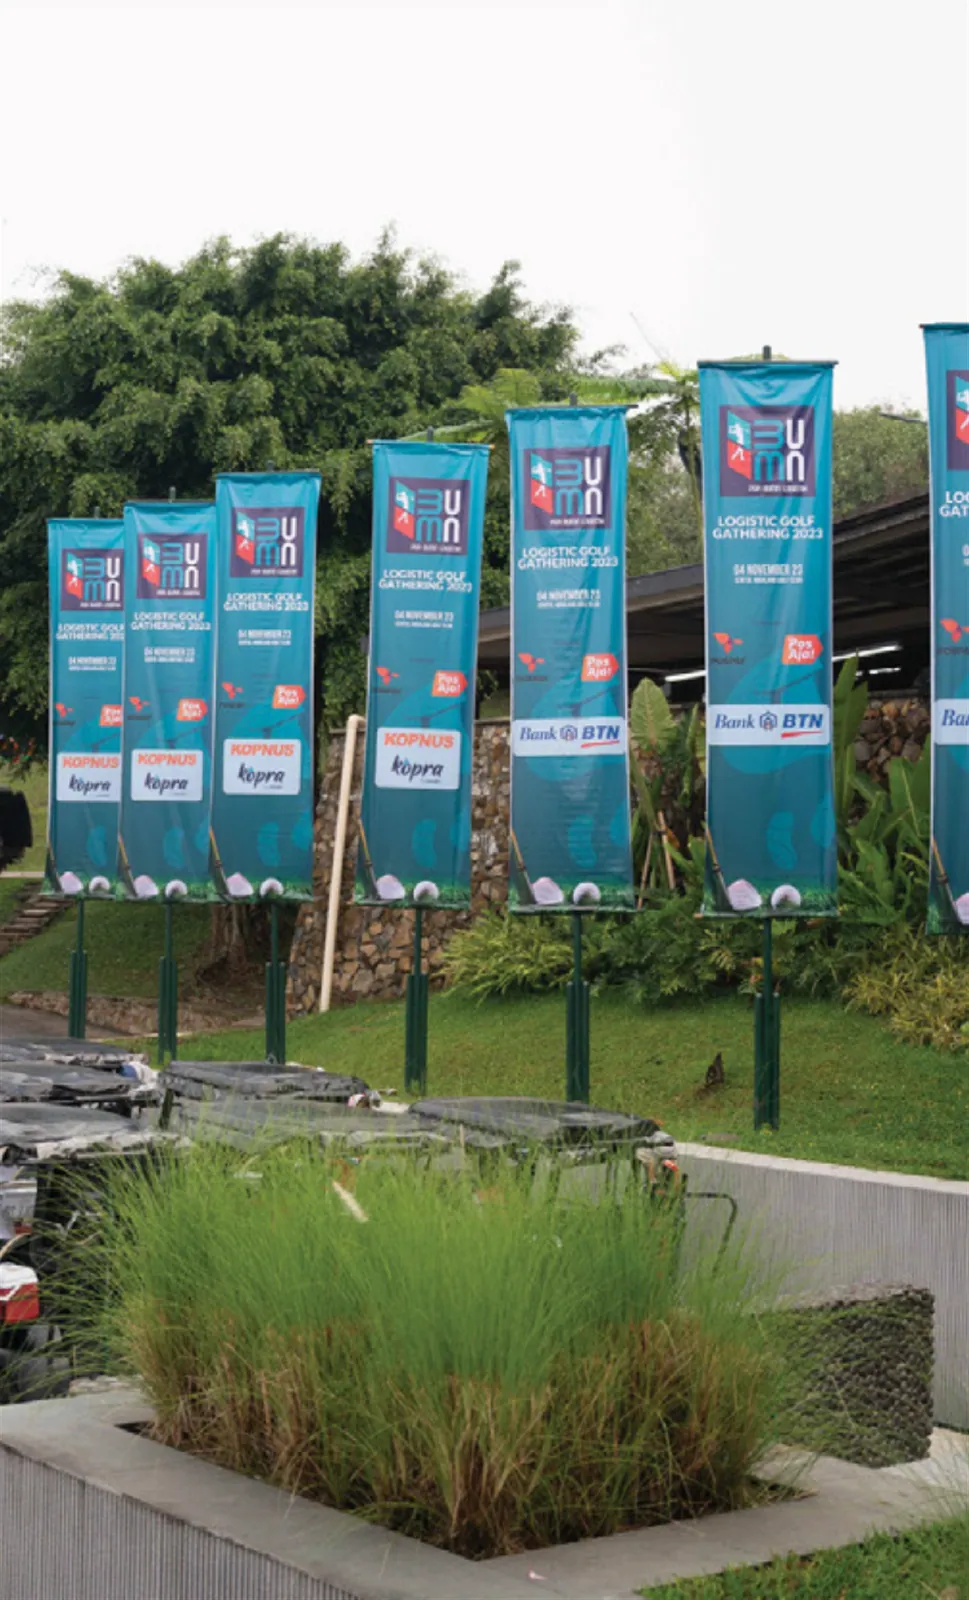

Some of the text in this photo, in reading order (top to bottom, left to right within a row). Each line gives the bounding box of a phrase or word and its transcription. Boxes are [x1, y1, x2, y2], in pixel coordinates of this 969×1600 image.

[718, 515, 816, 527] LOGISTIC GOLF
[712, 527, 824, 539] GATHERING 2023
[523, 545, 611, 558] LOGISTIC GOLF
[517, 556, 619, 570] GATHERING 2023
[383, 569, 467, 583] LOGISTIC GOLF
[378, 579, 473, 593] GATHERING 2023
[227, 592, 303, 601] LOGISTIC GOLF
[223, 602, 282, 611] GATHERING
[134, 611, 205, 620] LOGISTIC GOLF
[131, 622, 185, 630] GATHERING
[787, 637, 813, 648] Pos
[714, 713, 824, 729] Bank BTN
[519, 725, 621, 741] Bank BTN
[384, 732, 455, 748] KOPNUS
[230, 744, 294, 757] KOPNUS
[62, 756, 120, 769] KOPNUS
[137, 753, 197, 766] KOPNUS
